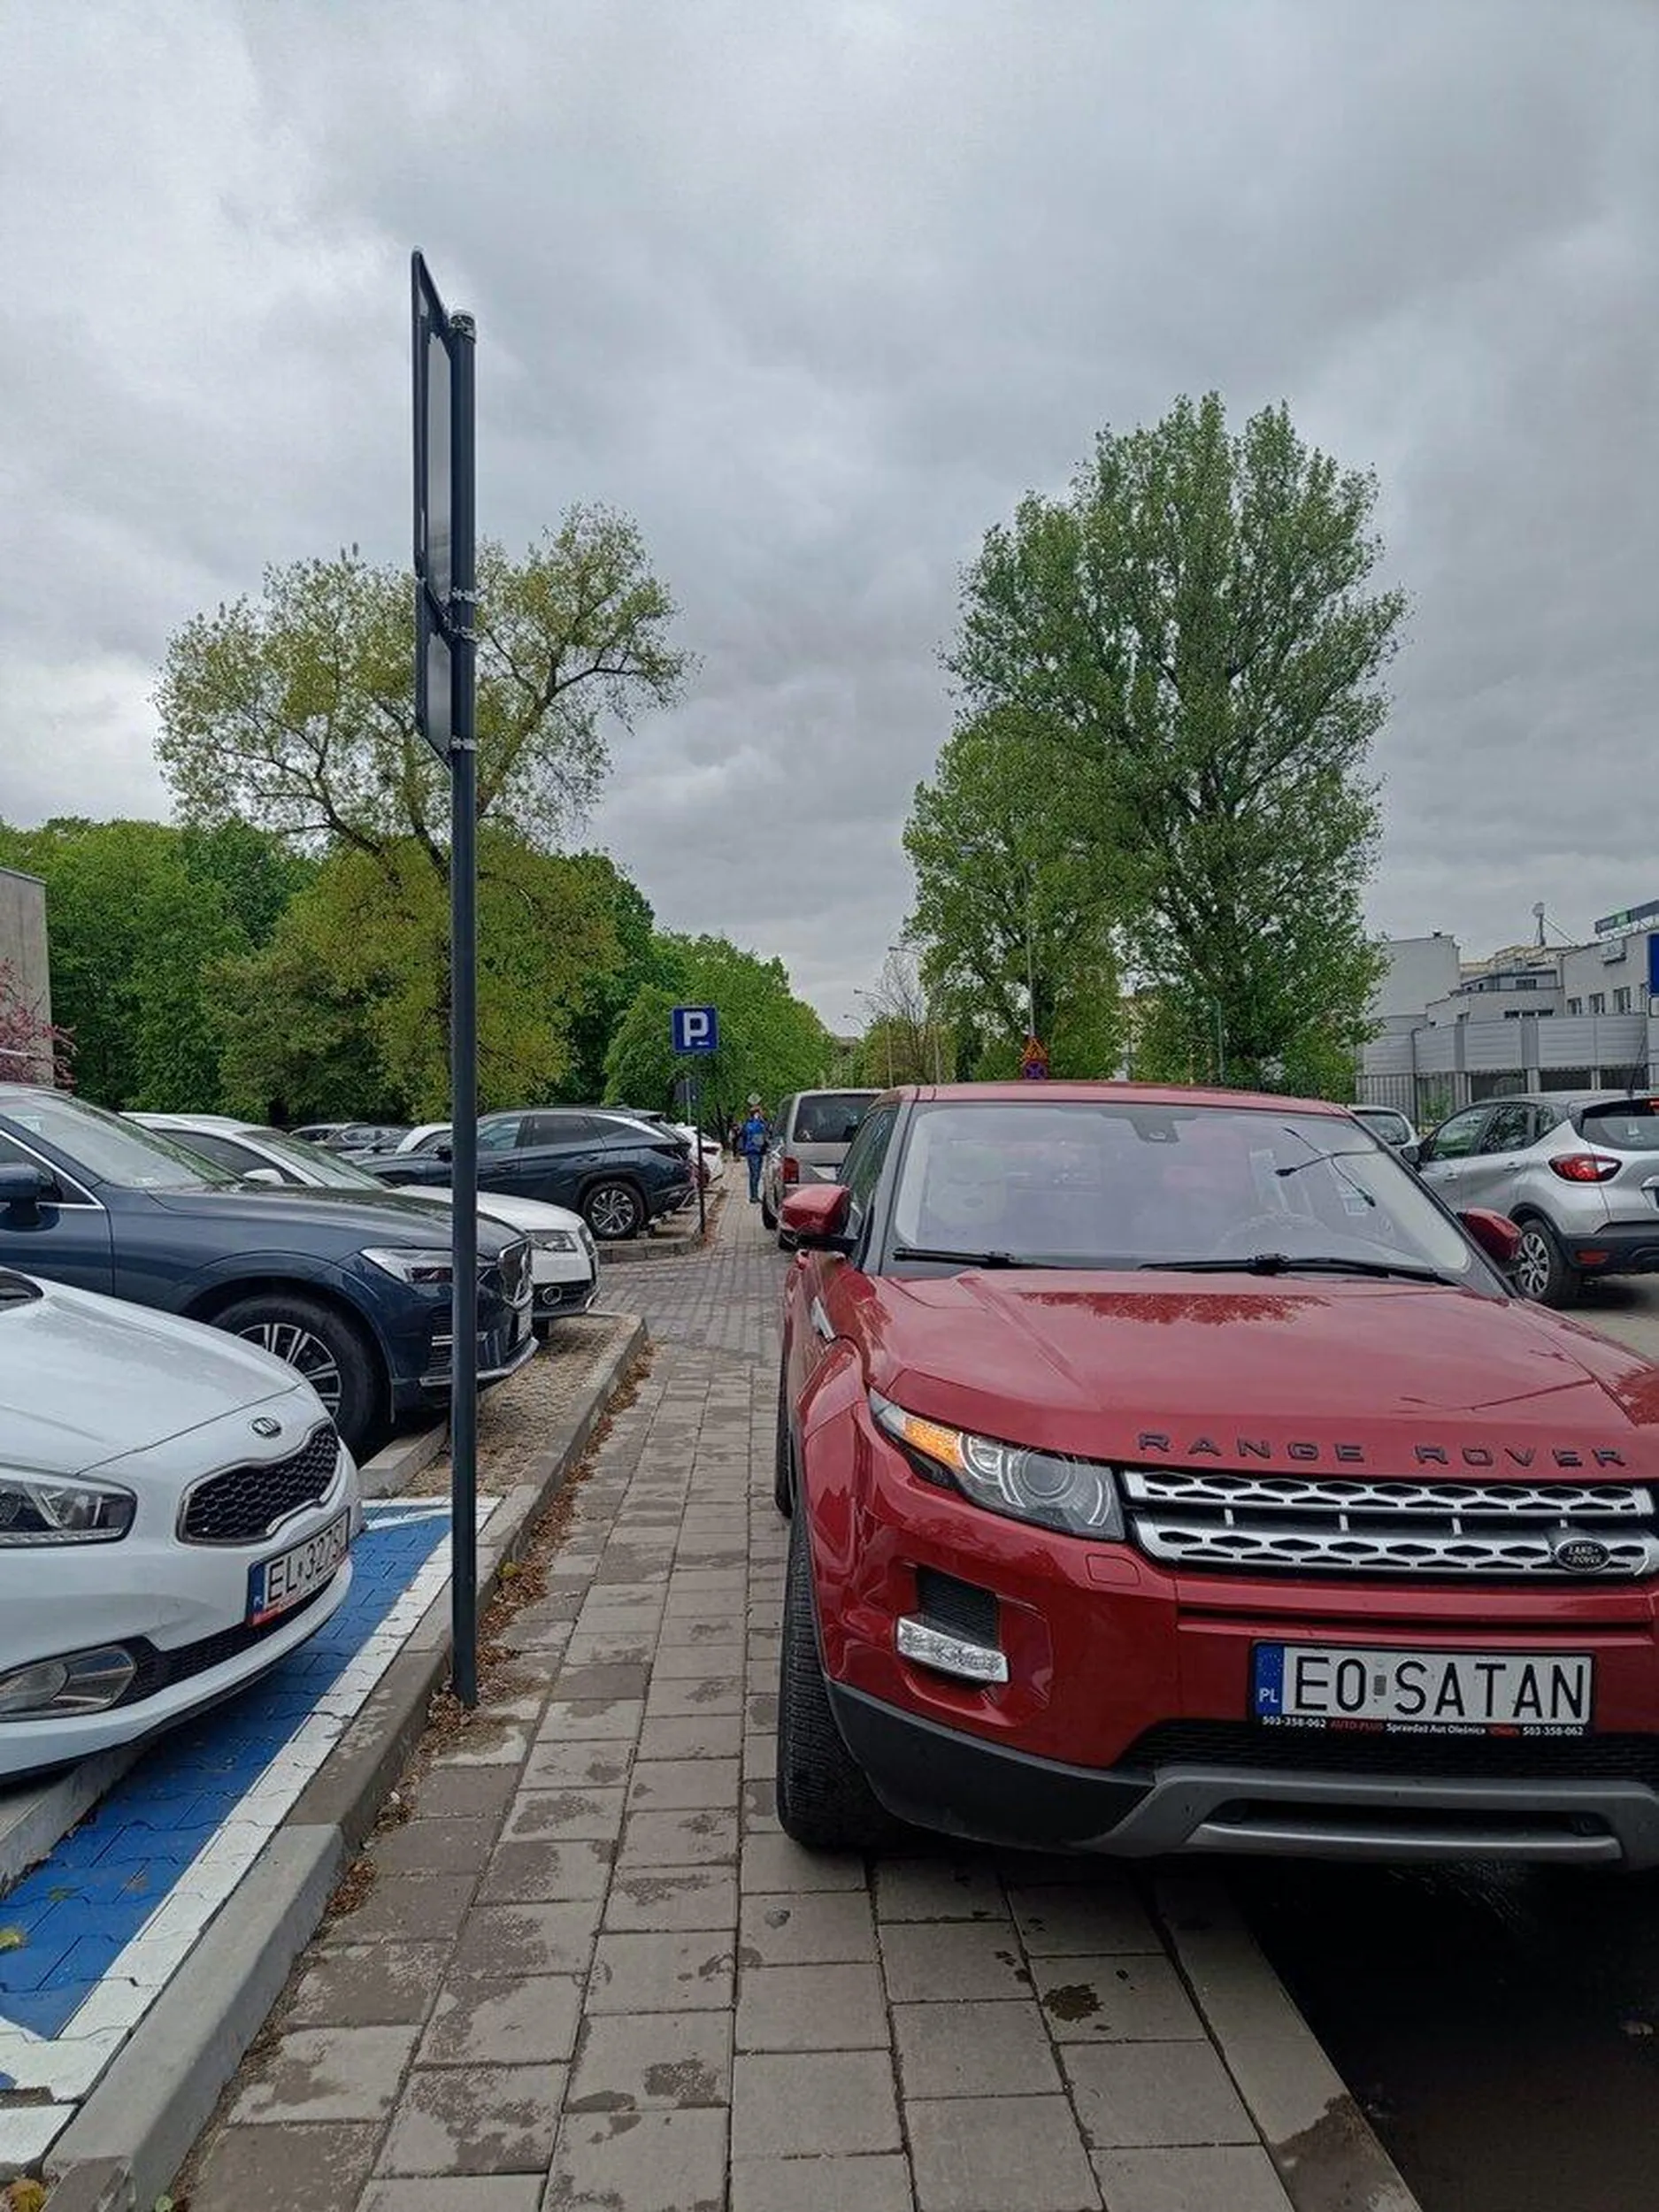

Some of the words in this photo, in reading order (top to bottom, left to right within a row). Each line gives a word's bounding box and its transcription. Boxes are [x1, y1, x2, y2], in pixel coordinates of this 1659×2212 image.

[683, 1011, 709, 1047] P
[1138, 1432, 1365, 1463] RANGE
[1415, 1446, 1626, 1467] ROVER
[1259, 1688, 1279, 1705] PL
[1394, 1661, 1585, 1719] SATAN
